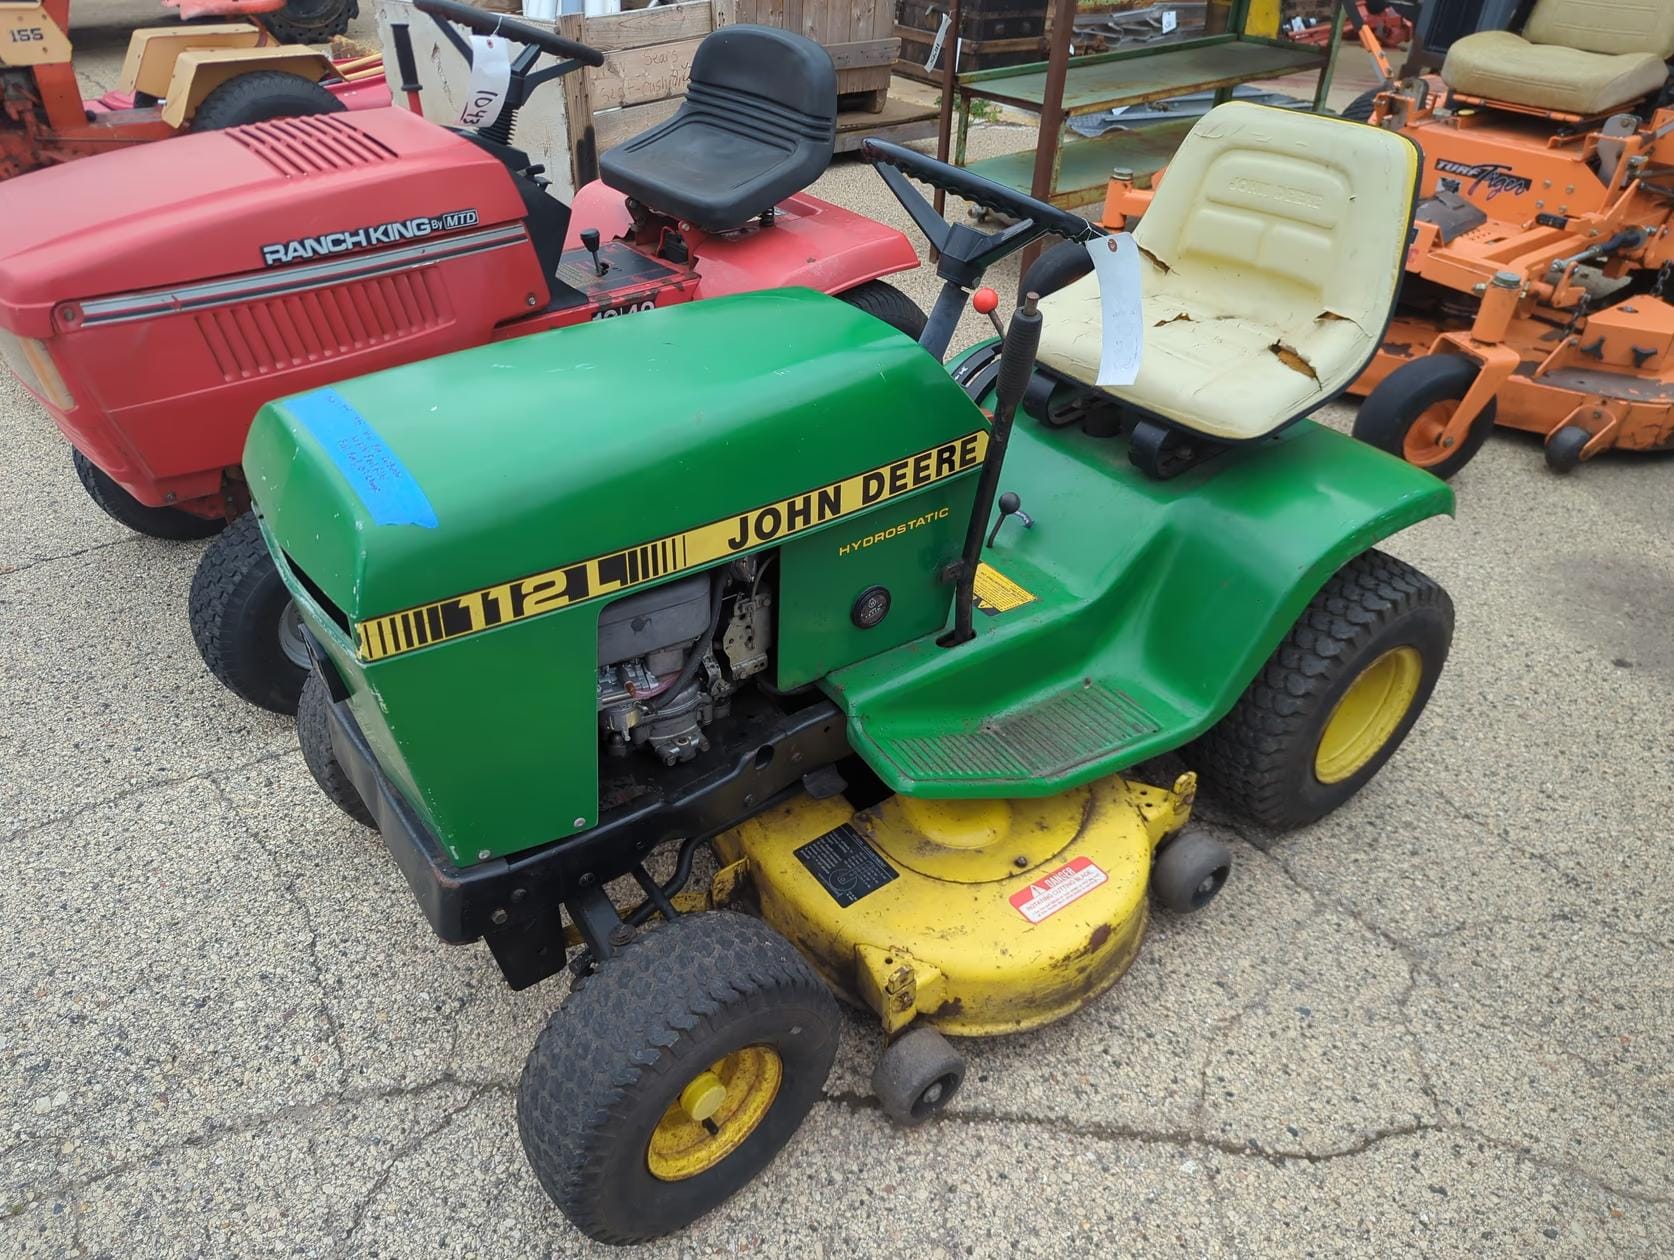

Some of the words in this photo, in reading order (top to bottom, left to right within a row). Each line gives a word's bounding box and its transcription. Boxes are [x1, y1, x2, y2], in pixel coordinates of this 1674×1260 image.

[10, 27, 44, 43] 155
[463, 90, 498, 125] 1043
[1436, 161, 1480, 176] TURF
[263, 229, 368, 265] RANCH
[370, 218, 432, 245] KING
[432, 219, 443, 230] By
[447, 211, 476, 227] MTD
[728, 484, 843, 551] JOHN
[861, 434, 978, 506] DEERE
[839, 507, 949, 557] HYDROSTATIC
[458, 570, 569, 632] 112
[586, 560, 622, 598] L
[1043, 866, 1076, 888] DANGER
